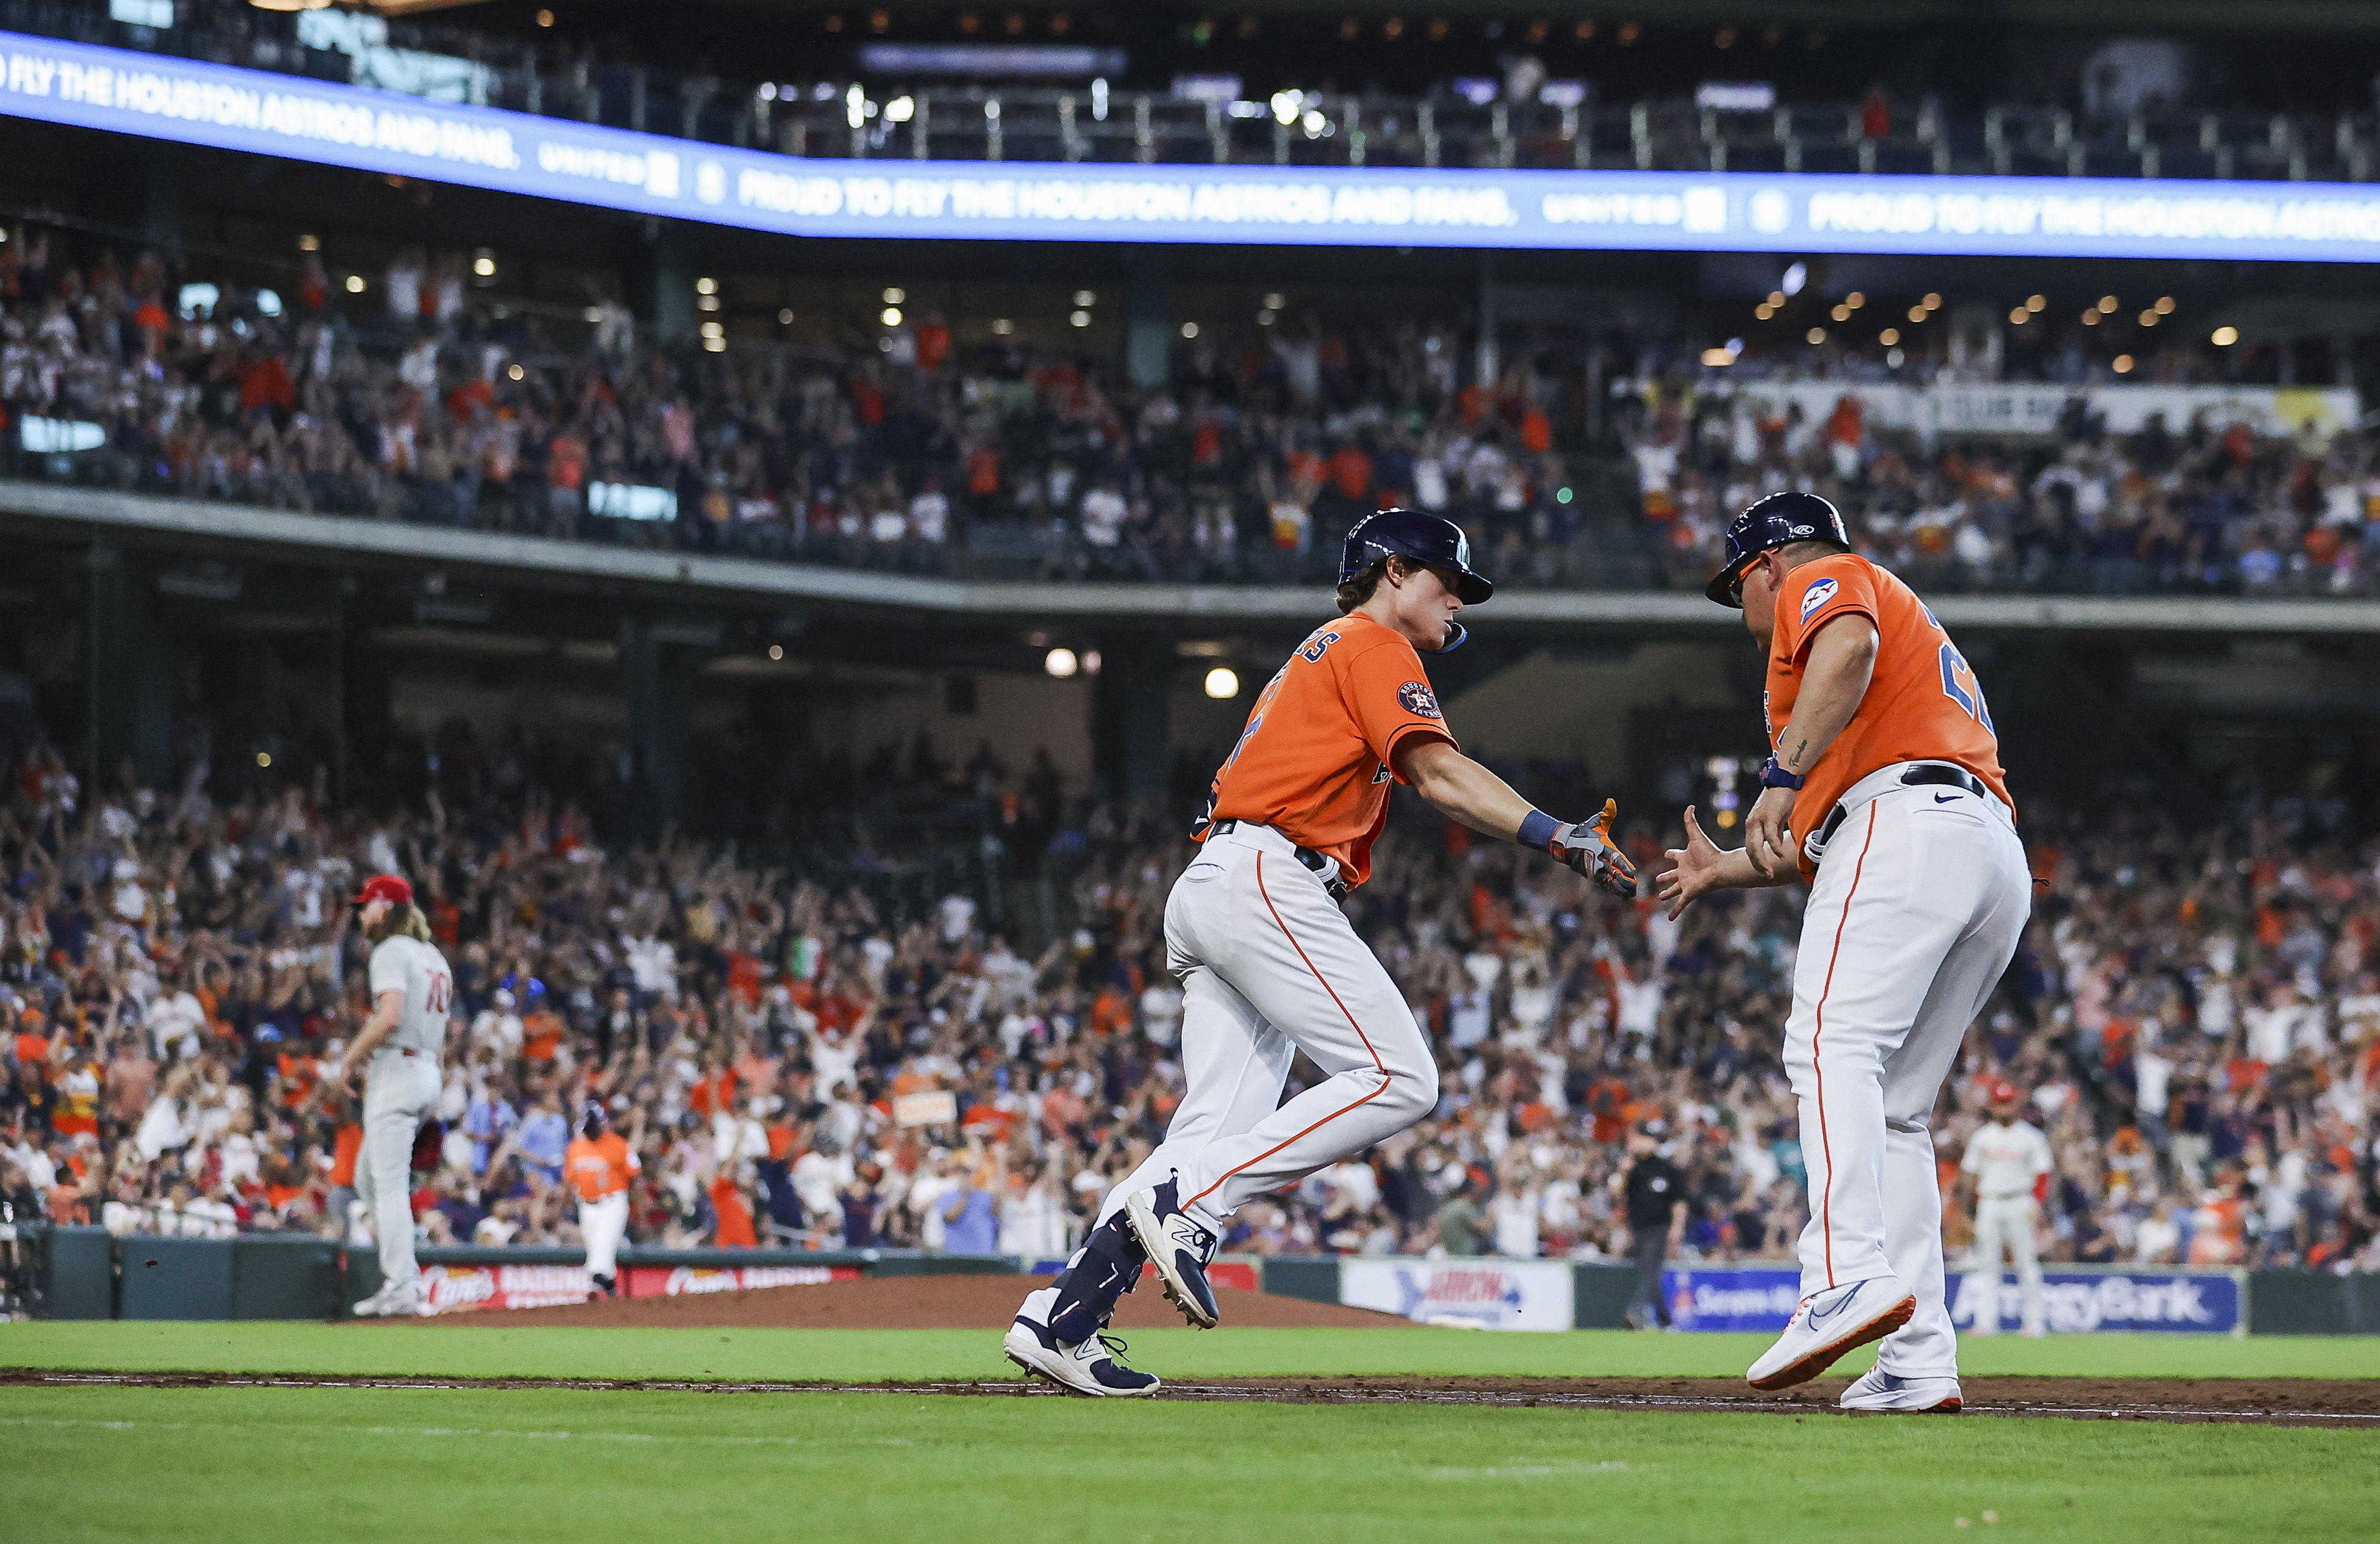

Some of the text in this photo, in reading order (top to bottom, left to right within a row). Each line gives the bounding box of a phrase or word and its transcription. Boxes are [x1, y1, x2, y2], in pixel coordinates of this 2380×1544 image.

[9, 54, 55, 96] FLY
[59, 61, 114, 107] THE
[116, 69, 261, 129] HOUSTON
[262, 92, 374, 147] ASTROS
[376, 109, 439, 157] AND
[739, 168, 843, 216] PROUD
[844, 176, 893, 217] TO
[893, 178, 951, 218] FLY
[951, 179, 1016, 218] THE
[1018, 179, 1192, 222] HOUSTON
[1192, 182, 1333, 225] ASTROS
[1333, 185, 1412, 225] AND
[2104, 196, 2276, 239] HOUSTON
[1400, 683, 1433, 697] HOUSTON
[1412, 693, 1432, 709] H
